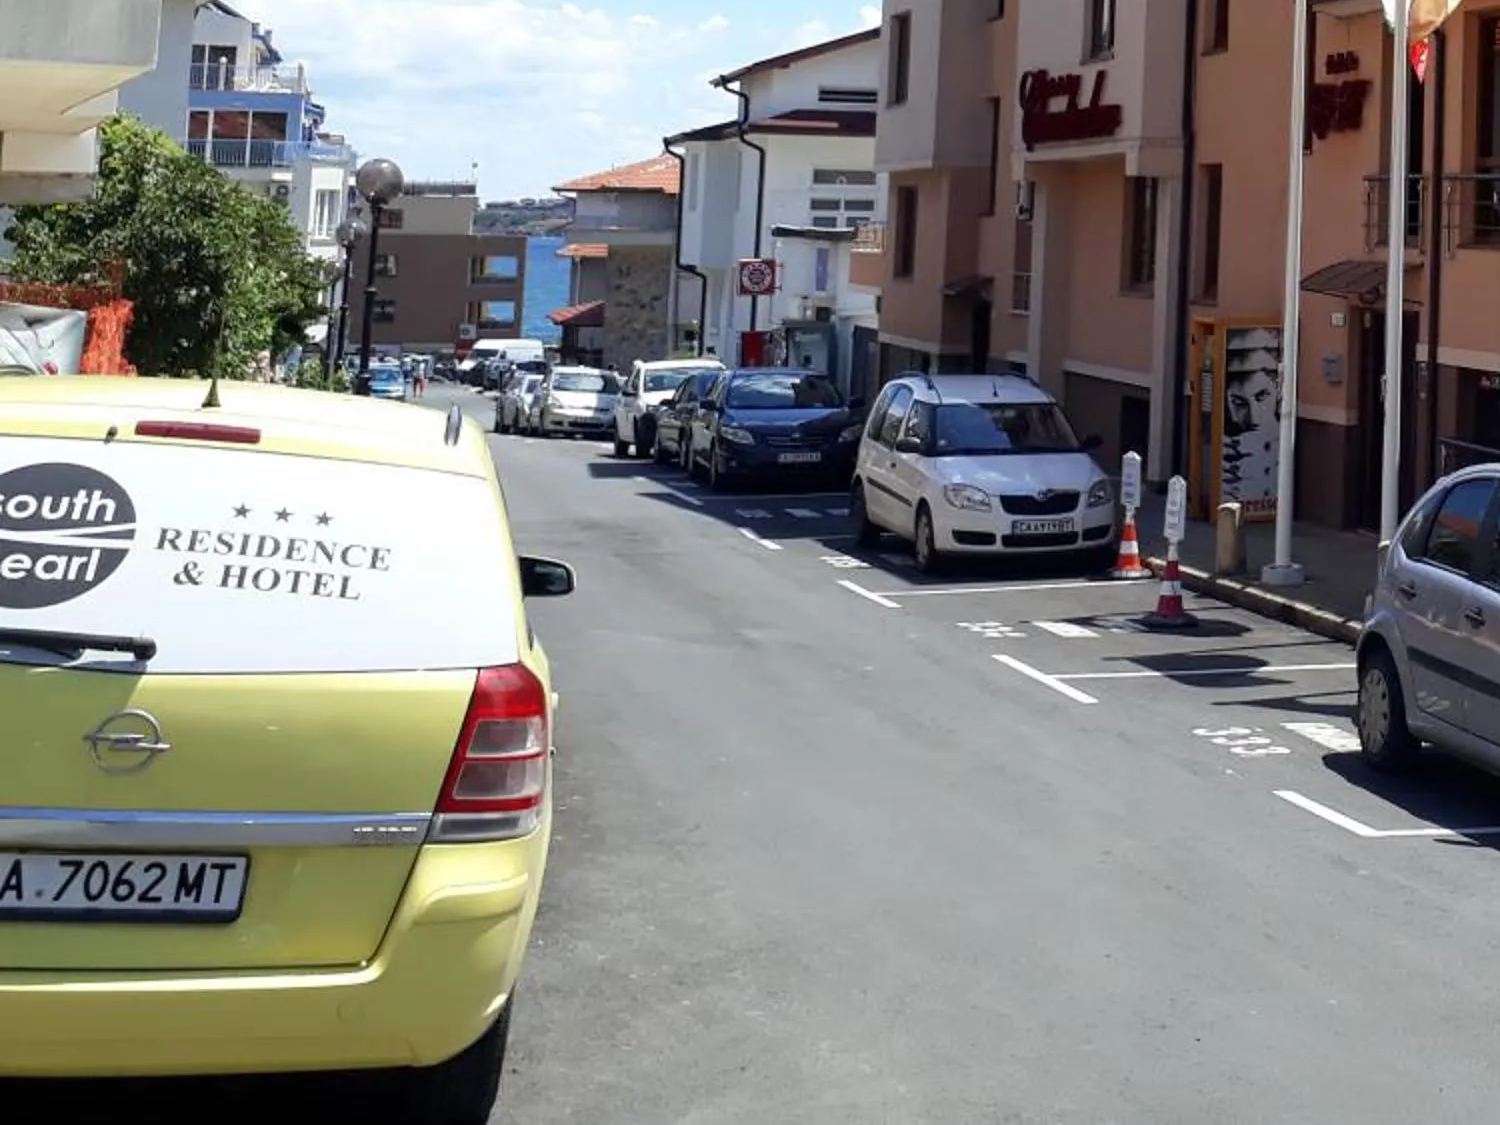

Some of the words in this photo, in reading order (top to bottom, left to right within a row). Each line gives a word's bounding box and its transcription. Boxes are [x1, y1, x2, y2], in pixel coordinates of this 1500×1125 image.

[0, 489, 117, 522] outh
[0, 548, 101, 582] earl
[153, 526, 393, 572] RESIDENCE
[173, 560, 205, 587] &
[217, 562, 362, 601] HOTEL
[52, 859, 168, 903] 7062
[173, 862, 238, 904] MT
